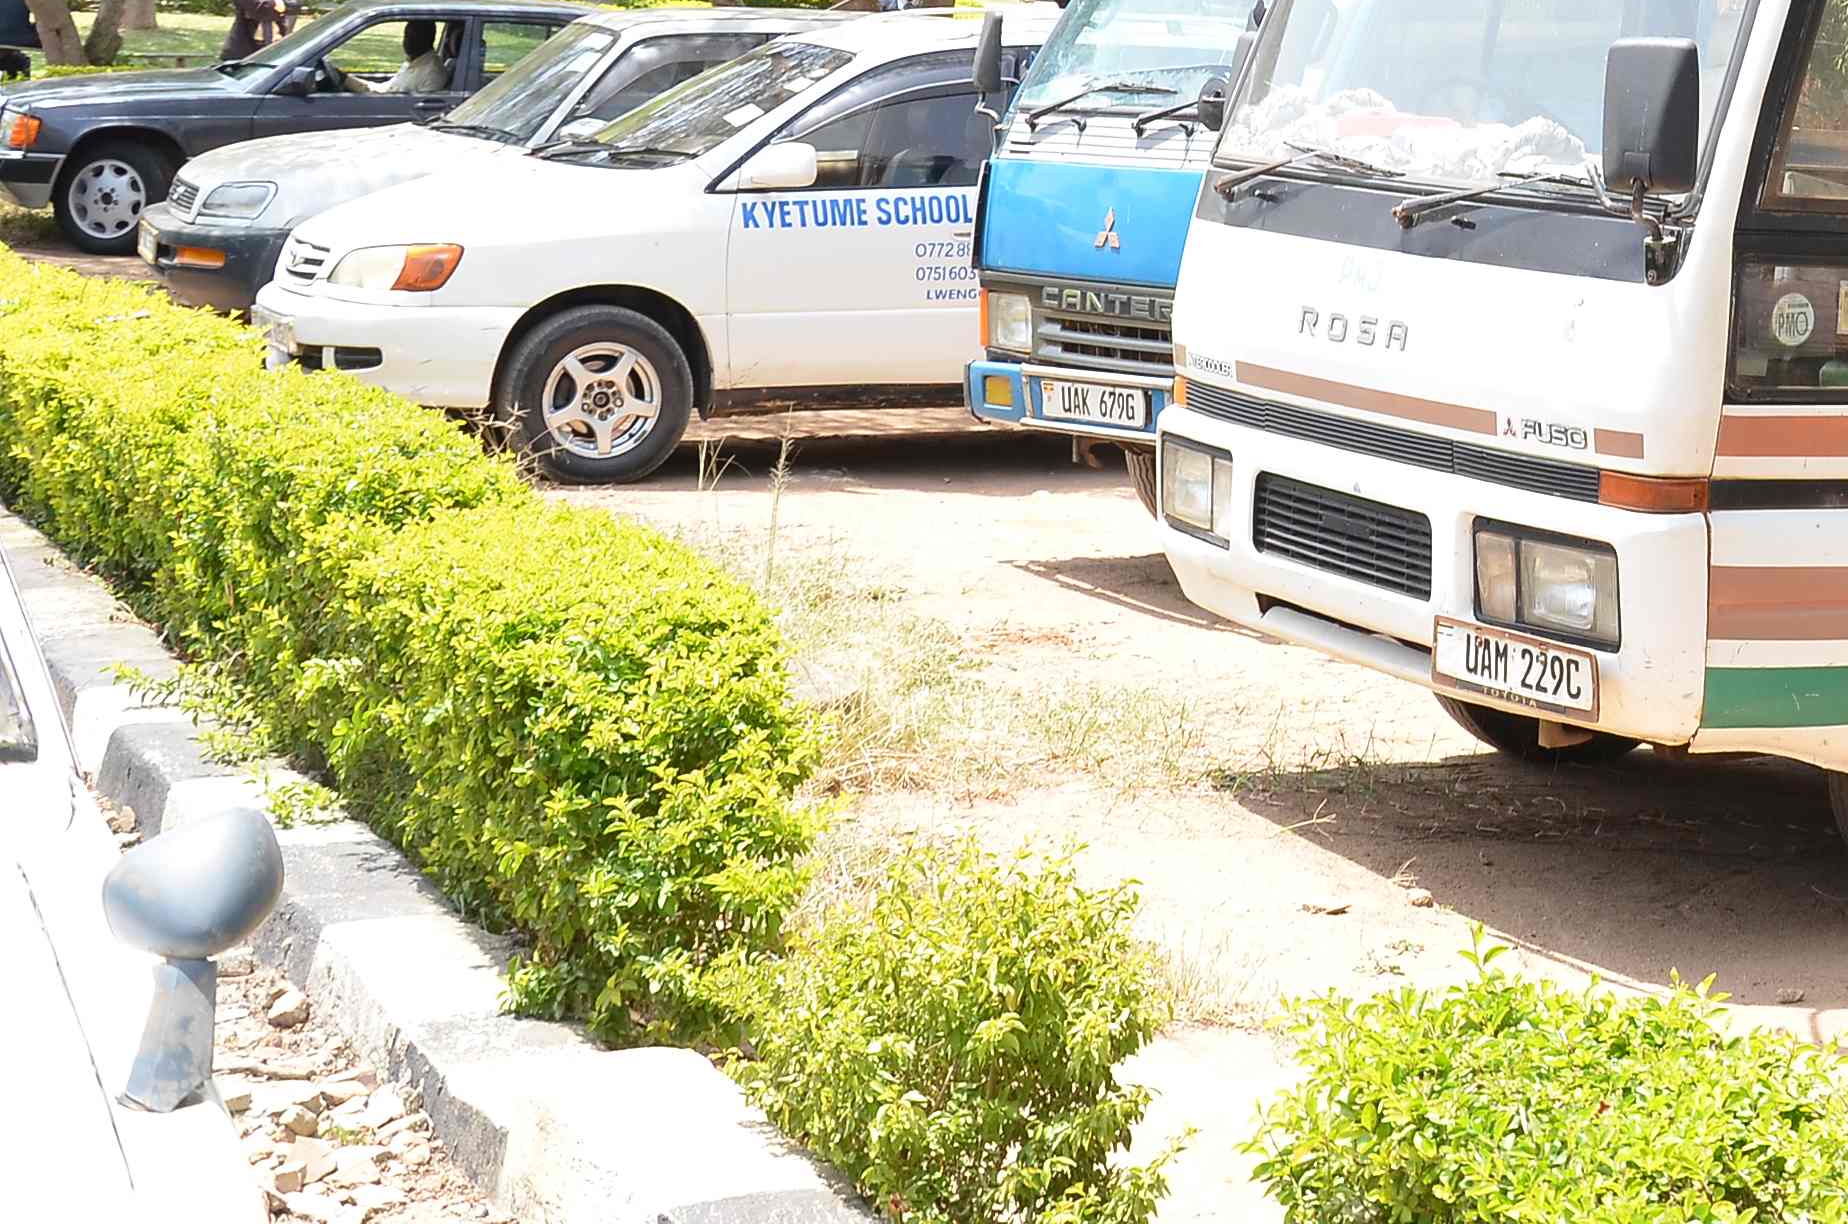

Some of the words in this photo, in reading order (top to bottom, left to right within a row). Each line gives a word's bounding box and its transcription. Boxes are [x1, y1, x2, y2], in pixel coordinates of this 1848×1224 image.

[741, 198, 868, 229] KYETUME
[875, 194, 973, 226] SCHOOL
[926, 287, 980, 300] LWENG
[1041, 286, 1172, 320] CANTER
[1297, 305, 1409, 352] ROSA
[1062, 385, 1091, 416] UAK
[1099, 390, 1136, 421] 679G
[1520, 418, 1587, 450] FUSO
[1465, 633, 1508, 684] UAM
[1520, 647, 1582, 700] 229C
[1481, 686, 1537, 709] TOYOTA
